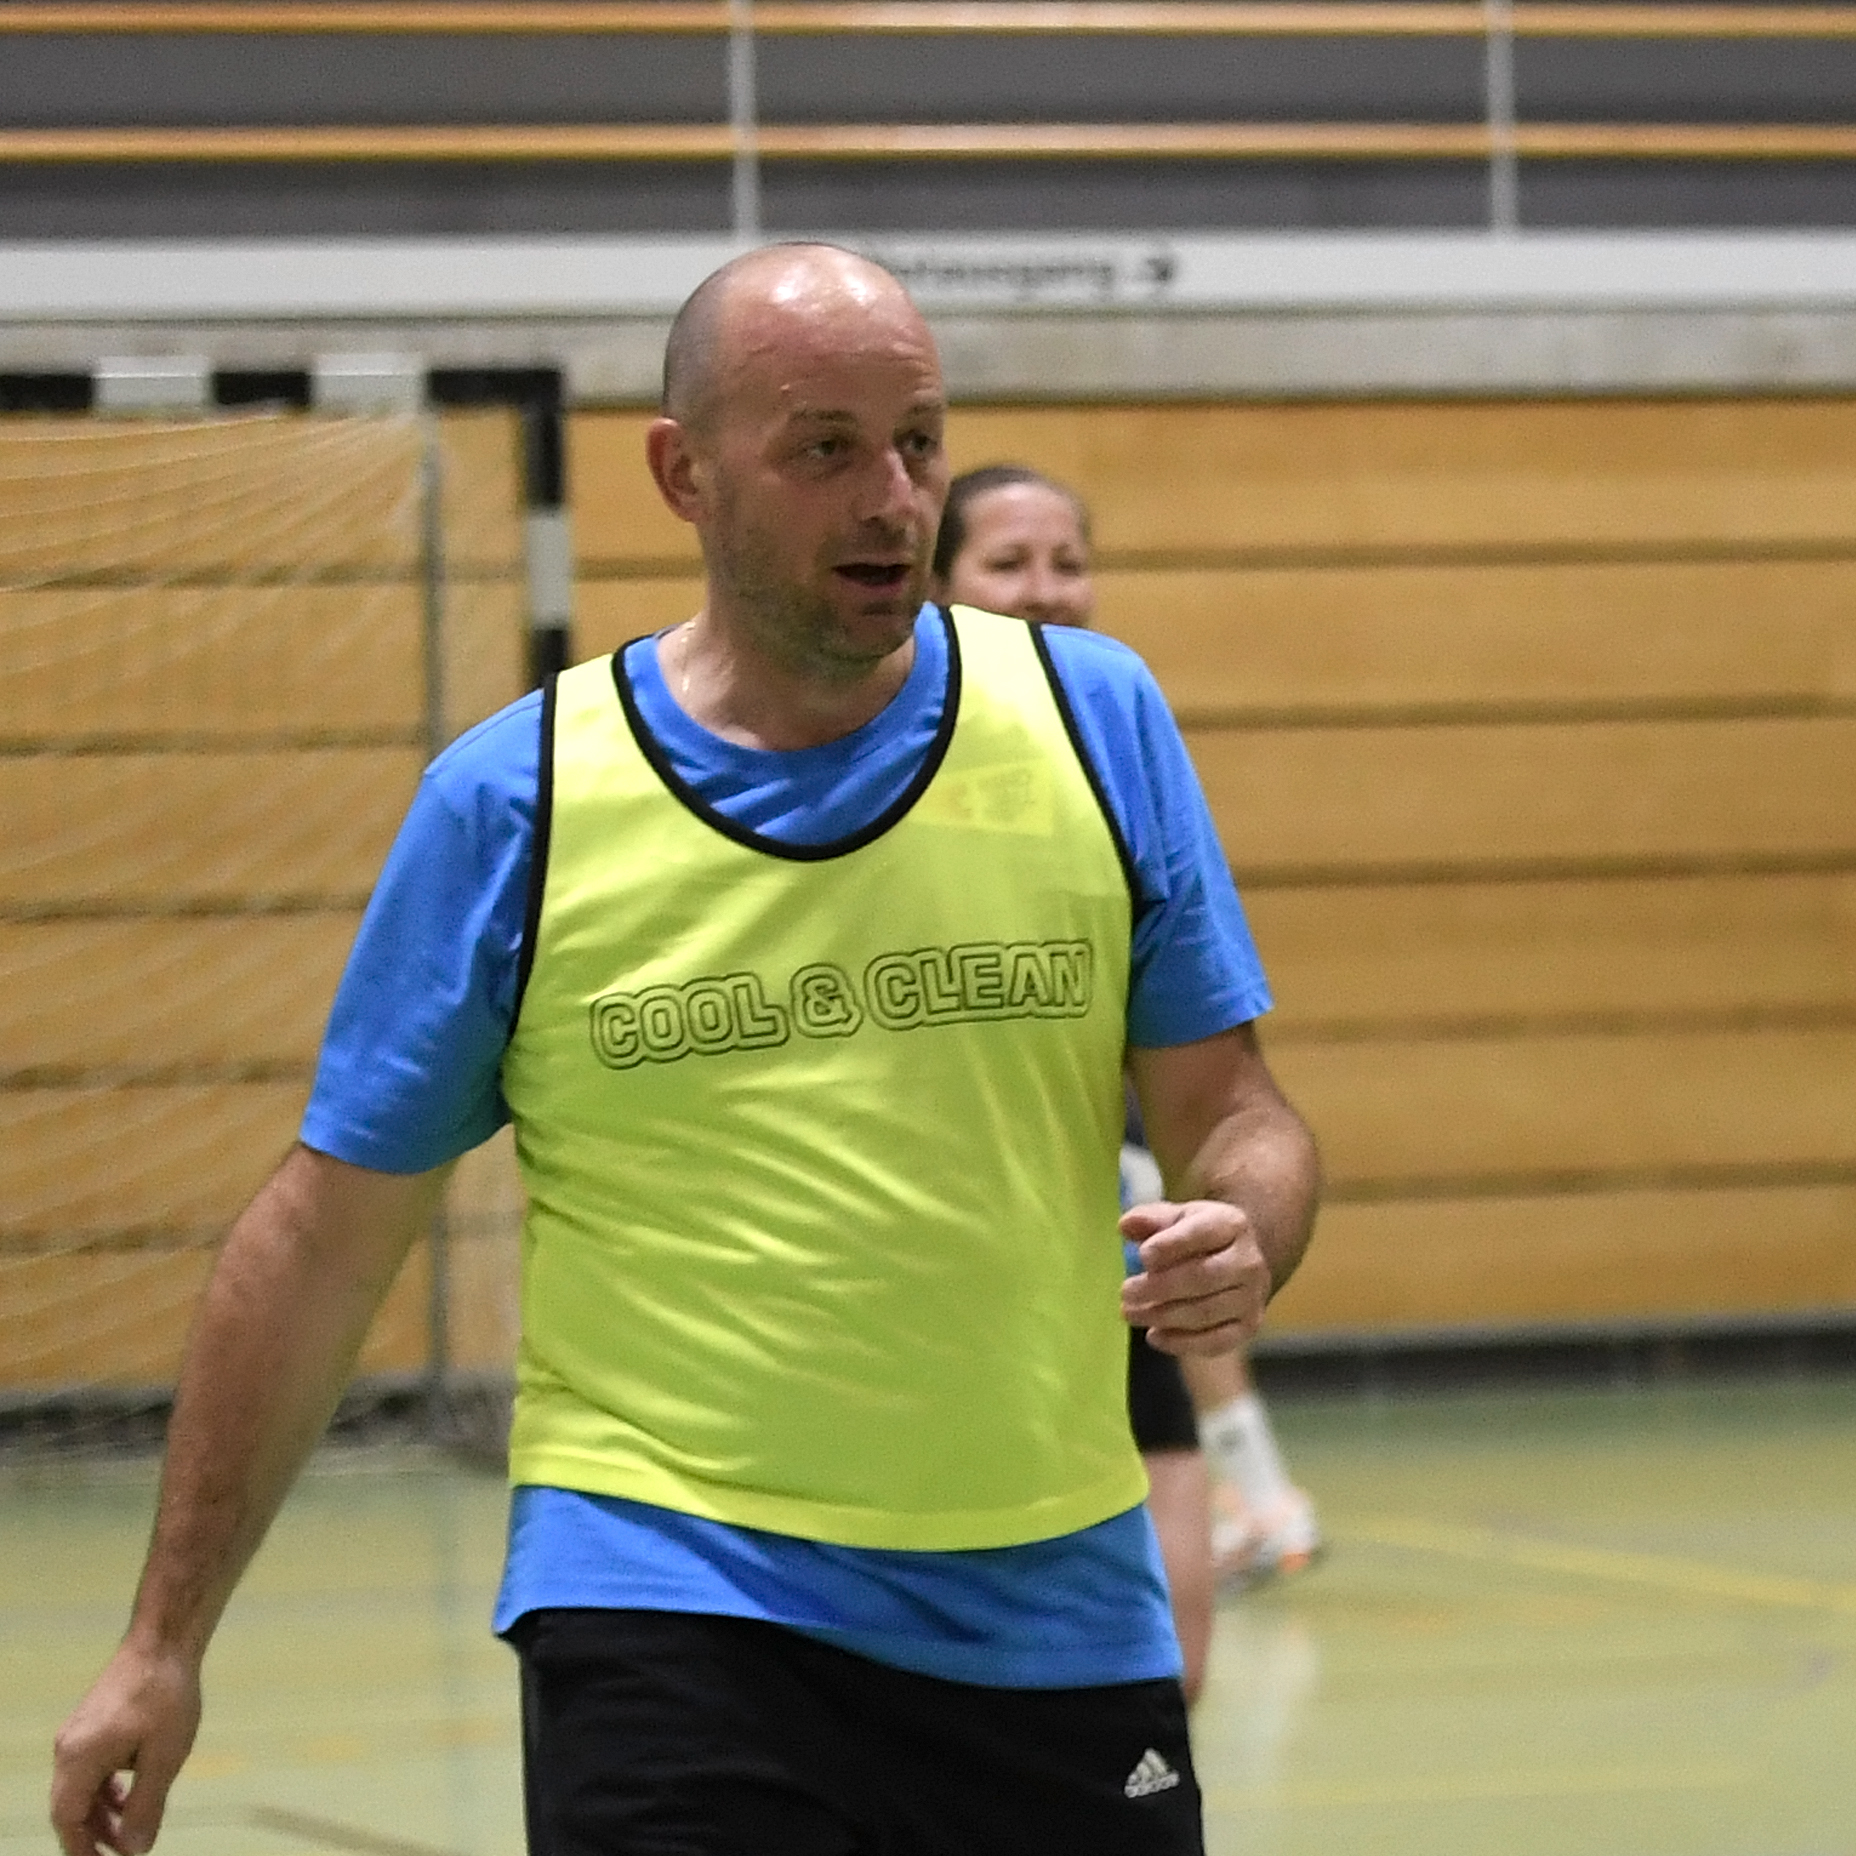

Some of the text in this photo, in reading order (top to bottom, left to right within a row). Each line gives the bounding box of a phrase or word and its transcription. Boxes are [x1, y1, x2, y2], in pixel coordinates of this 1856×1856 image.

[590, 937, 1094, 1070] COOL & CLEAN
